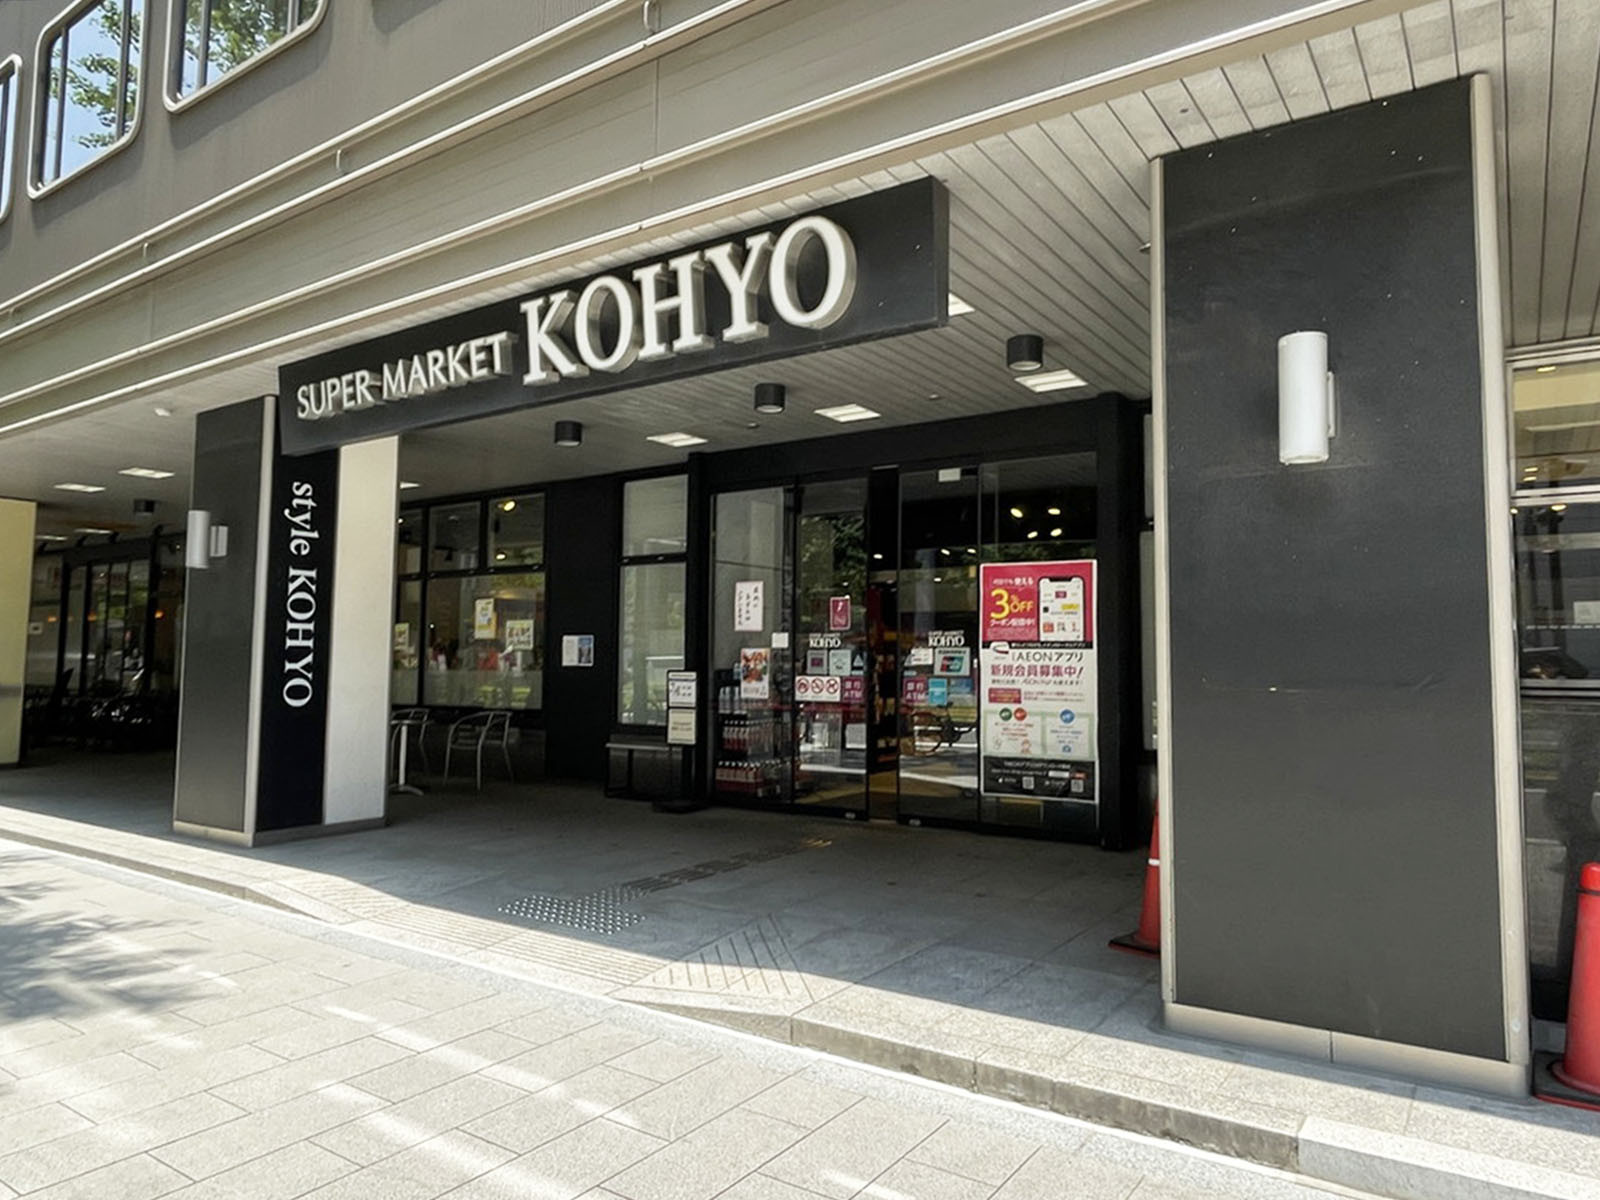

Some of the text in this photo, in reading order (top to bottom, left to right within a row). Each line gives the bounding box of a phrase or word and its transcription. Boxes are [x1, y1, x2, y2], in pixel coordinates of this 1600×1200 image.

[297, 215, 854, 420] SUPER MARKET KOHYO
[282, 480, 320, 708] style KOHYO
